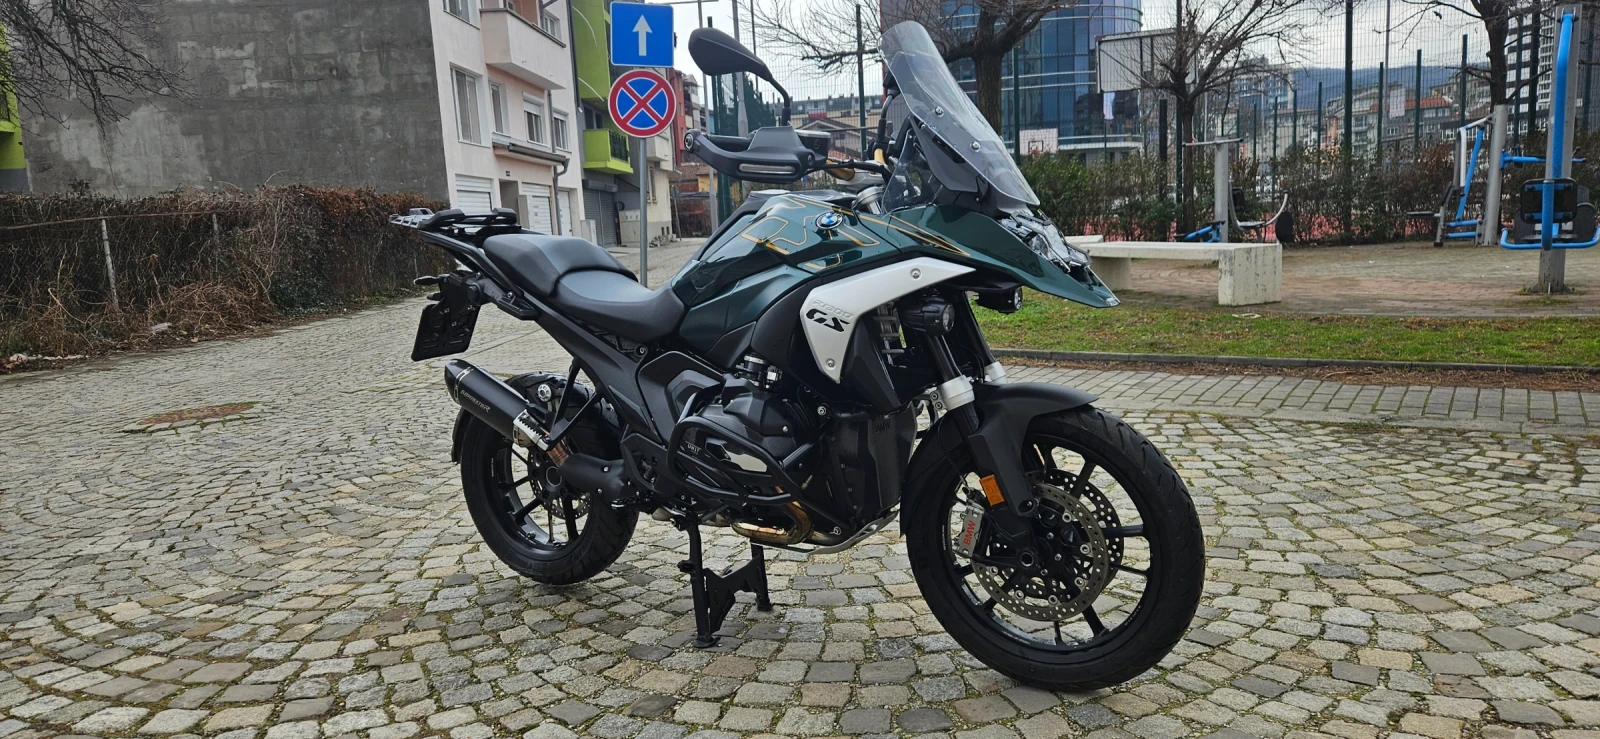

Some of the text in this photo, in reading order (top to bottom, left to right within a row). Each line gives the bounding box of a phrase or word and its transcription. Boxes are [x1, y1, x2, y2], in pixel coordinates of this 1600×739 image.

[805, 308, 851, 333] GS
[460, 389, 491, 413] DOMINATOR
[963, 520, 976, 546] BMW
